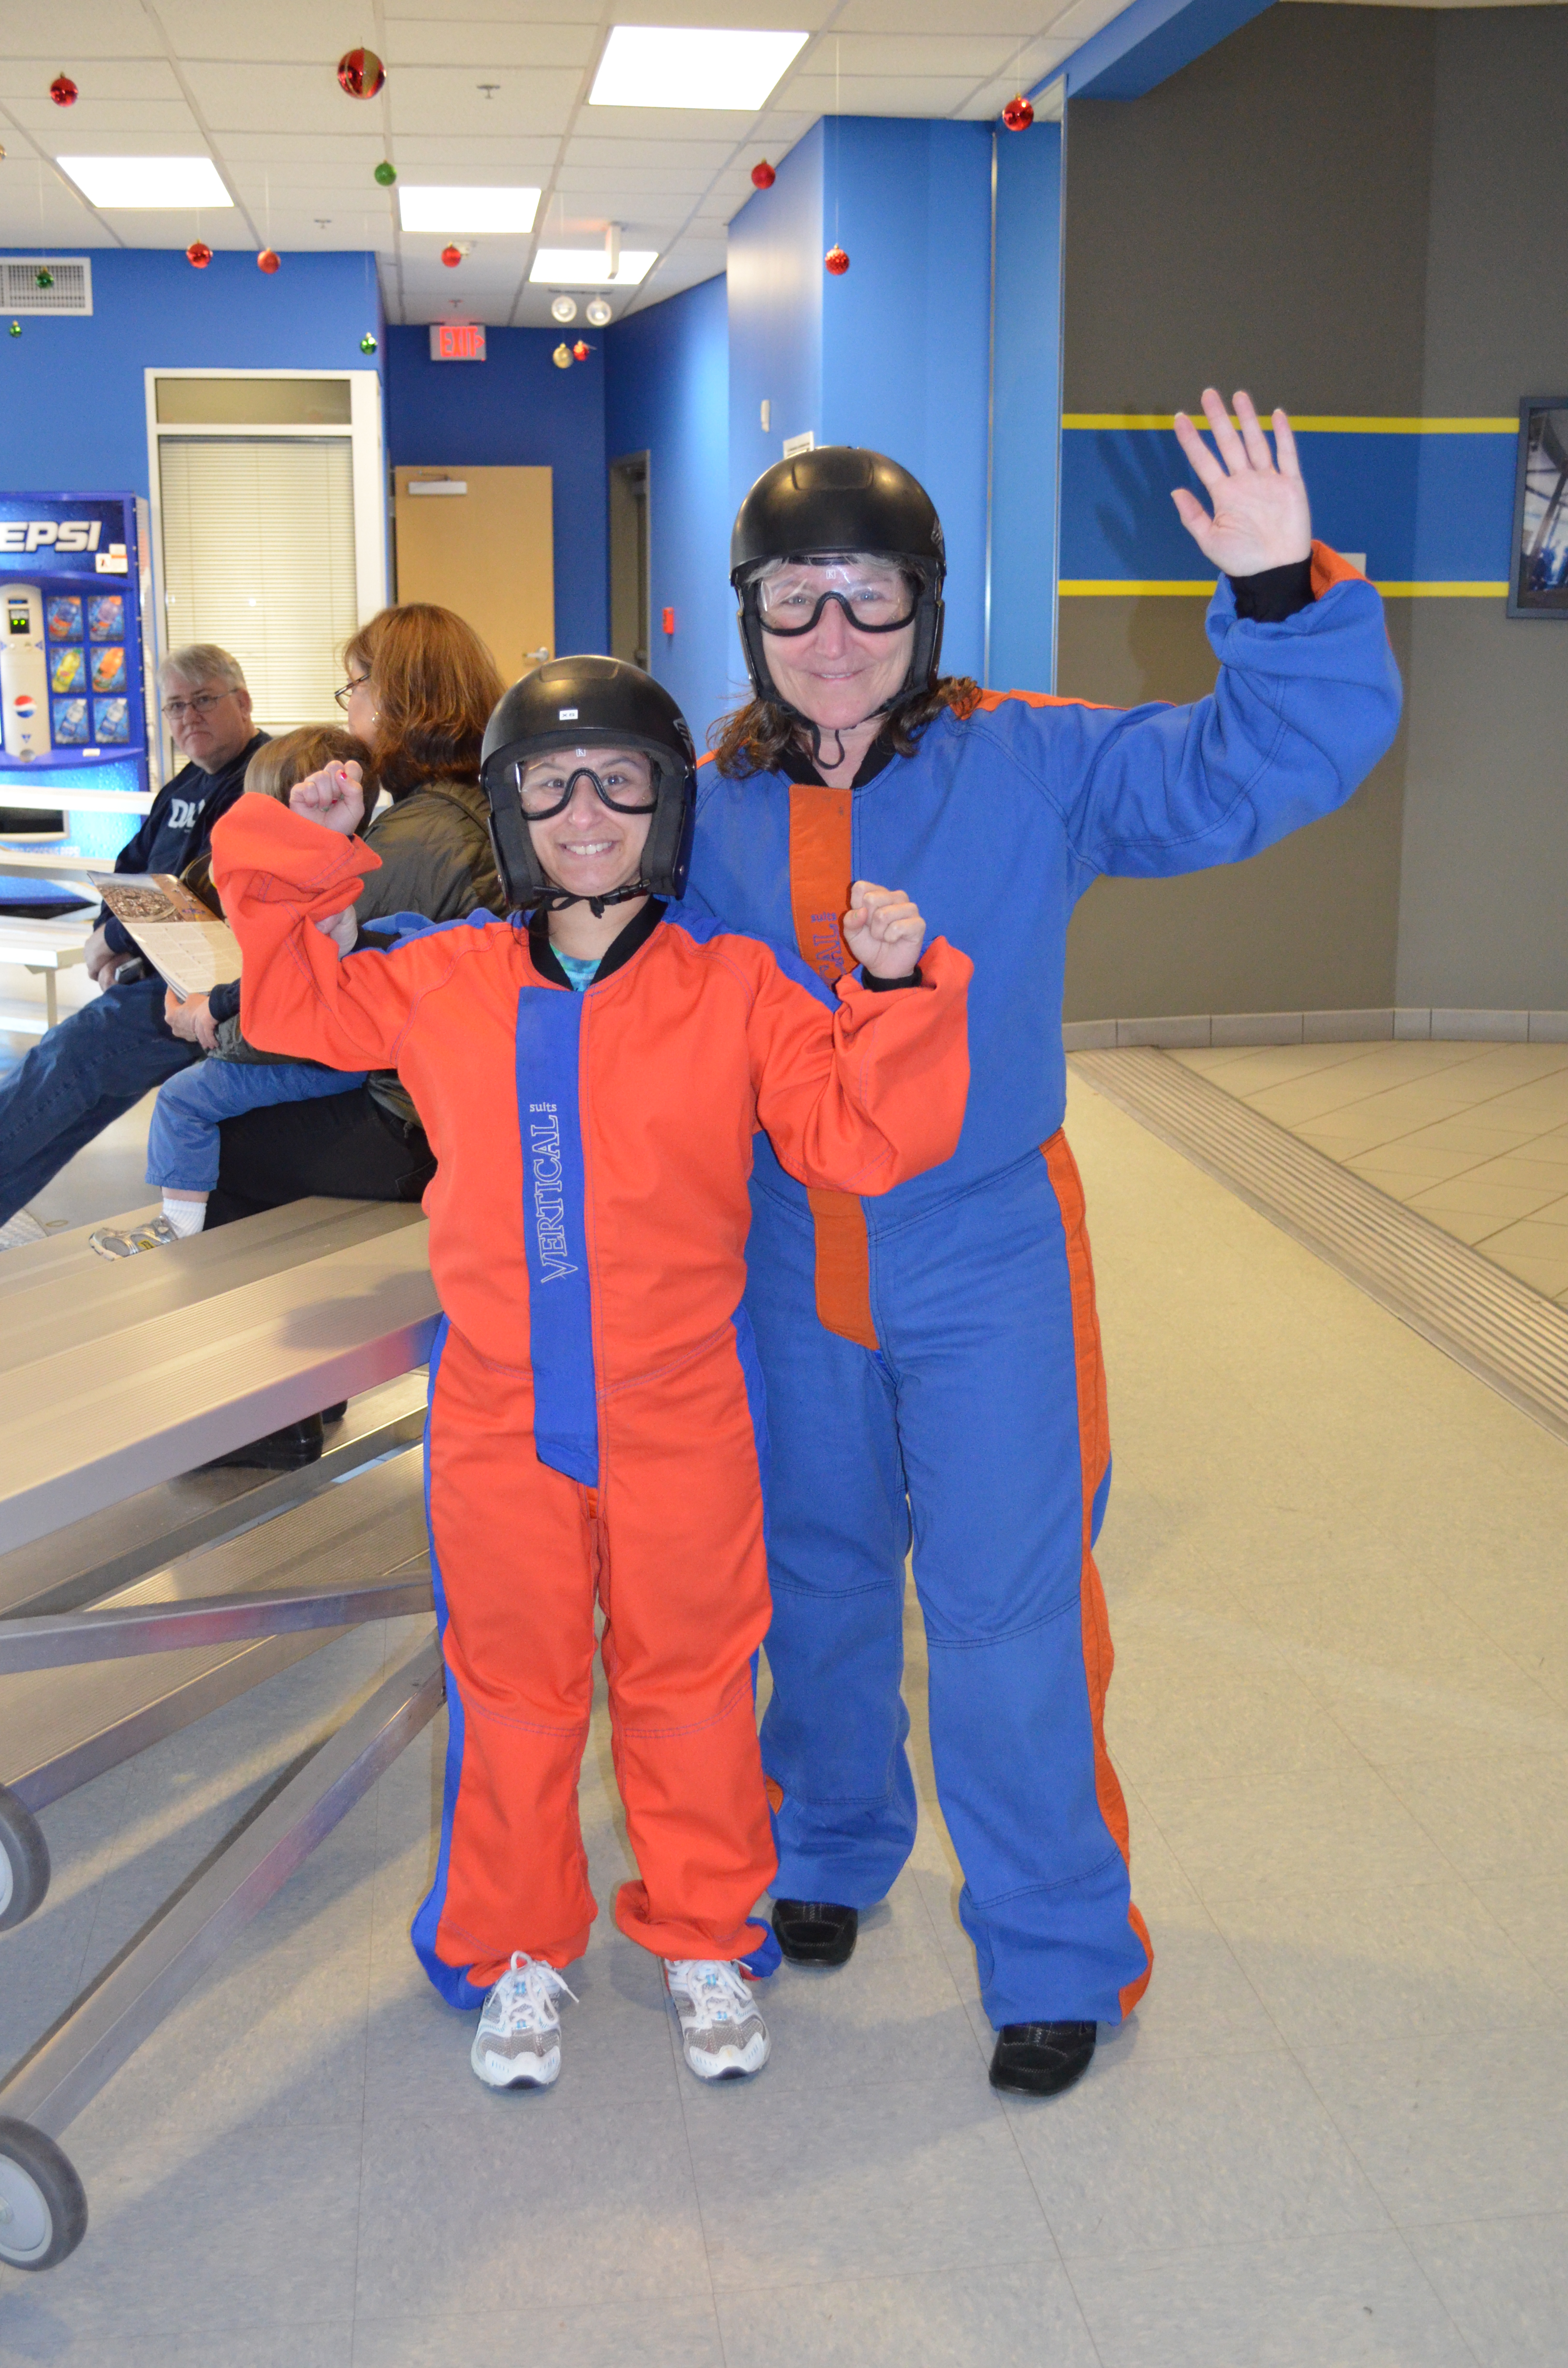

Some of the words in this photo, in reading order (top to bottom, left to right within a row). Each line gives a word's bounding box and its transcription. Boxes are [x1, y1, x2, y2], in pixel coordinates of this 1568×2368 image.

[439, 326, 478, 357] EXIT
[810, 911, 837, 923] suits
[529, 1102, 557, 1112] suits
[530, 1114, 578, 1283] VERTICAL
